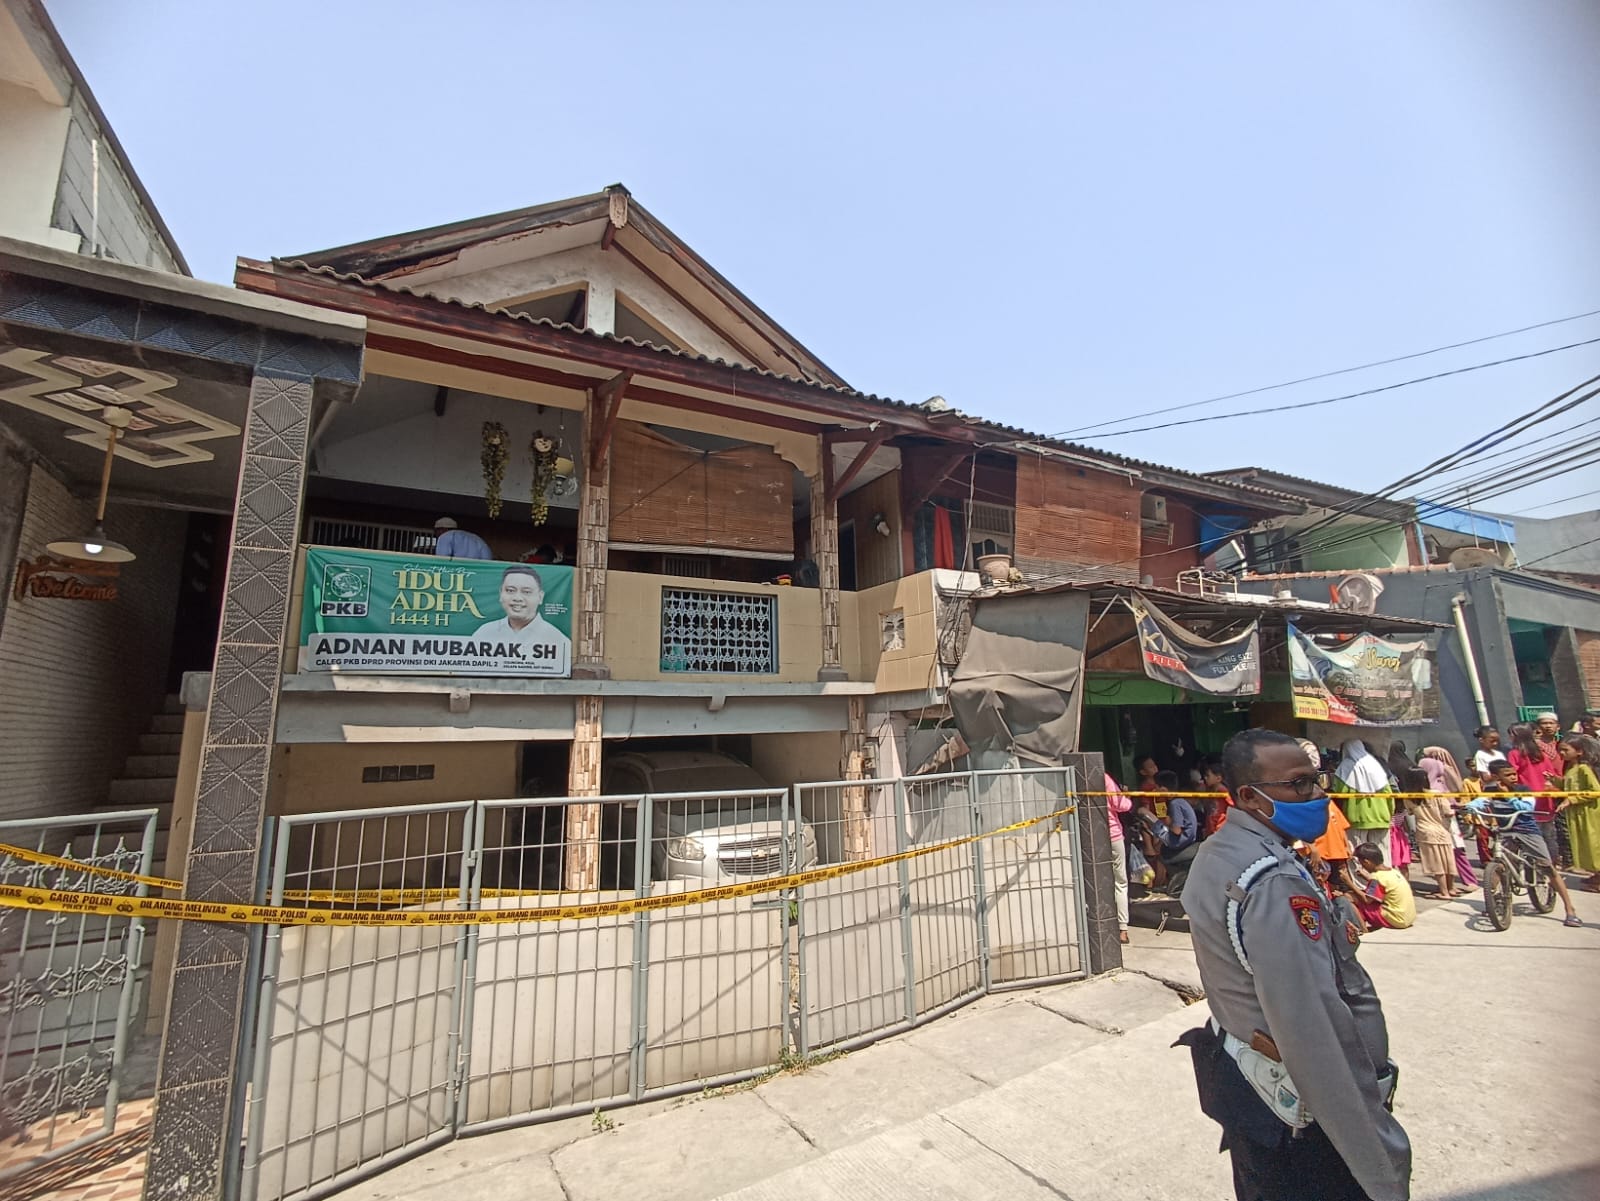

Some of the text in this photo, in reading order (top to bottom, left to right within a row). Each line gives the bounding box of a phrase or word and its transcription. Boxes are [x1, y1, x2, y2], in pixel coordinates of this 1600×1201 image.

[392, 569, 473, 593] IDUL
[322, 602, 367, 615] PKB
[390, 590, 486, 619] ADHA
[389, 612, 450, 626] 1444 H
[315, 638, 557, 661] ADNAN MUBARAK, SH
[315, 658, 342, 666] CALEG
[471, 660, 494, 668] DAPIL
[50, 892, 79, 904] GARIS
[82, 895, 113, 907] POLISI
[140, 900, 183, 911] DILARANG
[185, 903, 227, 914] MELINTAS
[252, 908, 277, 917] GARIS
[280, 910, 308, 919] POLISI
[330, 912, 369, 921] DILARANG
[370, 912, 408, 921] MELINTAS
[428, 913, 451, 921] GARIS
[453, 912, 477, 921] POLISI
[495, 910, 529, 919] DILARANG
[529, 908, 561, 917] MELINTAS
[578, 904, 597, 914] GARIS
[598, 903, 618, 912] POLISI
[634, 898, 660, 908] DILARANG
[661, 894, 688, 904] MELINTAS
[701, 890, 717, 899] GARIS
[717, 887, 734, 897] POLISI
[745, 882, 768, 891] DILARANG
